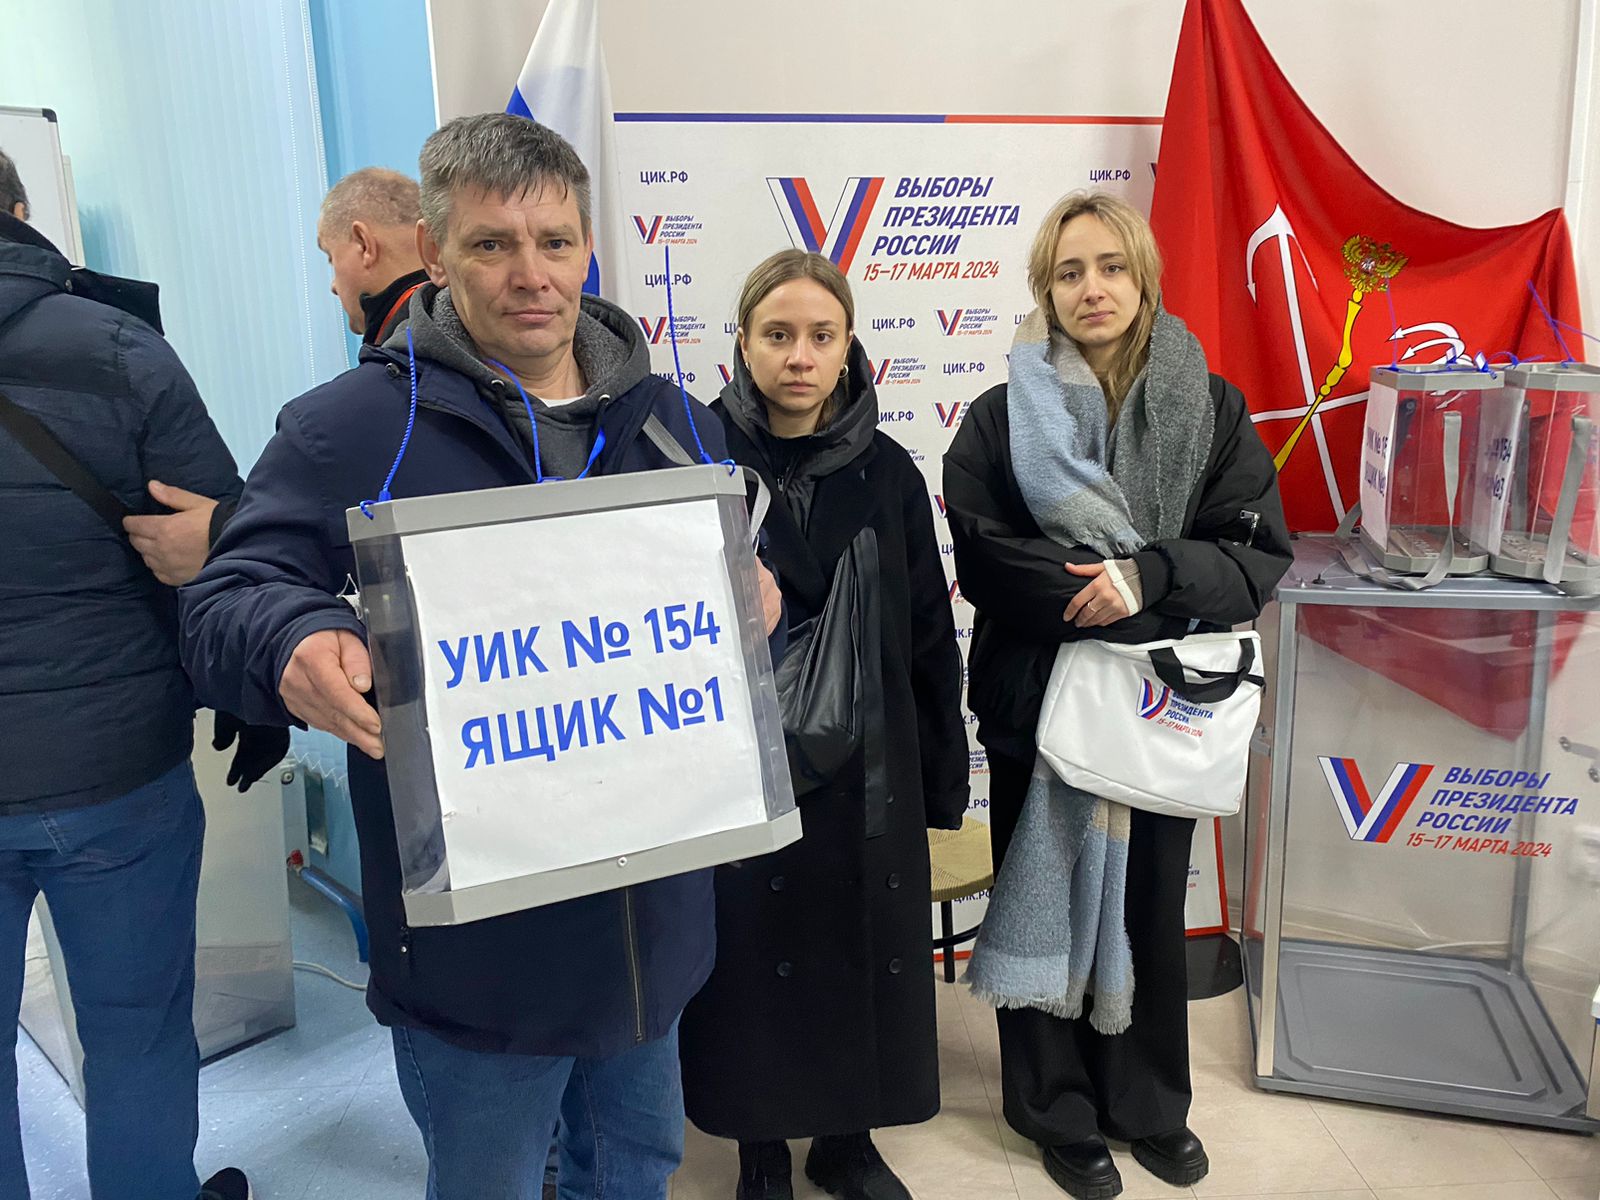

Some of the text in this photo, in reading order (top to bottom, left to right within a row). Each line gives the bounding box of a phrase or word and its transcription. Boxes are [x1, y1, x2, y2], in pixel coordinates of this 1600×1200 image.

[640, 170, 688, 186] ЦИК.РФ
[1089, 169, 1131, 183] ЦИК.РФ
[894, 176, 993, 198] ВЫБОРЫ
[662, 222, 703, 230] ПРЕЗИДЕНТА
[882, 205, 1020, 230] ПРЕЗИДЕНТА
[660, 230, 686, 238] РОССИИ
[871, 234, 962, 256] РОССИИ
[908, 261, 960, 281] МАРТА
[962, 260, 999, 279] 2024
[672, 315, 698, 323] ЫБОРЫ
[872, 317, 916, 332] ЦИК.РФ
[943, 362, 985, 376] ЦИК.РФ
[880, 410, 915, 422] ИК.РФ
[437, 600, 721, 689] УИК № 154
[1170, 699, 1213, 719] ПРЕЗИДЕНТА
[460, 675, 725, 769] ЯЩИК №1
[1443, 766, 1551, 789] ВЫБОРЫ
[1429, 789, 1579, 816] ПРЕЗИДЕНТА
[1416, 811, 1512, 834] РОССИИ
[1452, 836, 1509, 855] МАРТА
[1510, 841, 1553, 858] 2024
